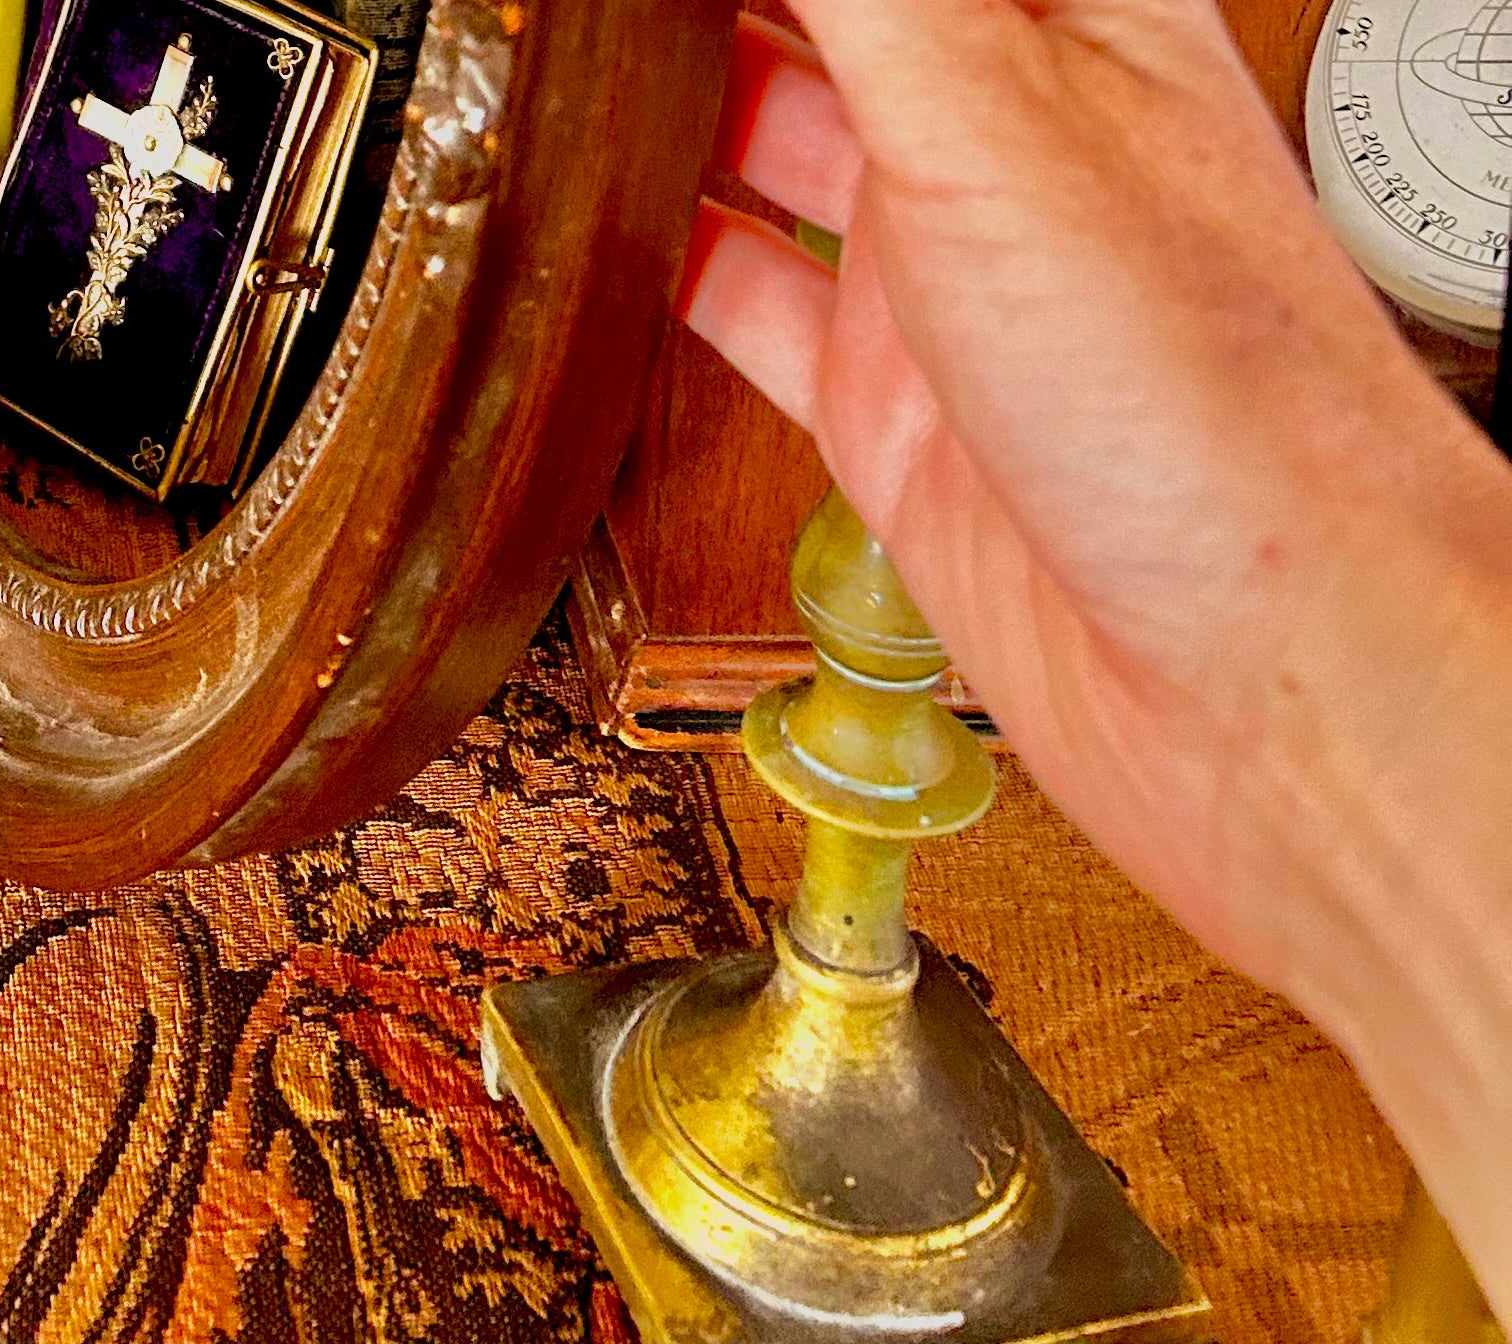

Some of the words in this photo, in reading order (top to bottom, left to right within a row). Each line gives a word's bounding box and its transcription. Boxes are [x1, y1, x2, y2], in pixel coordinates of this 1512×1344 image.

[1352, 16, 1374, 52] 550
[1351, 93, 1372, 121] 175
[1361, 131, 1391, 167] 200
[1385, 172, 1419, 202] 225
[1420, 203, 1458, 230] 250
[1477, 230, 1509, 248] 30
